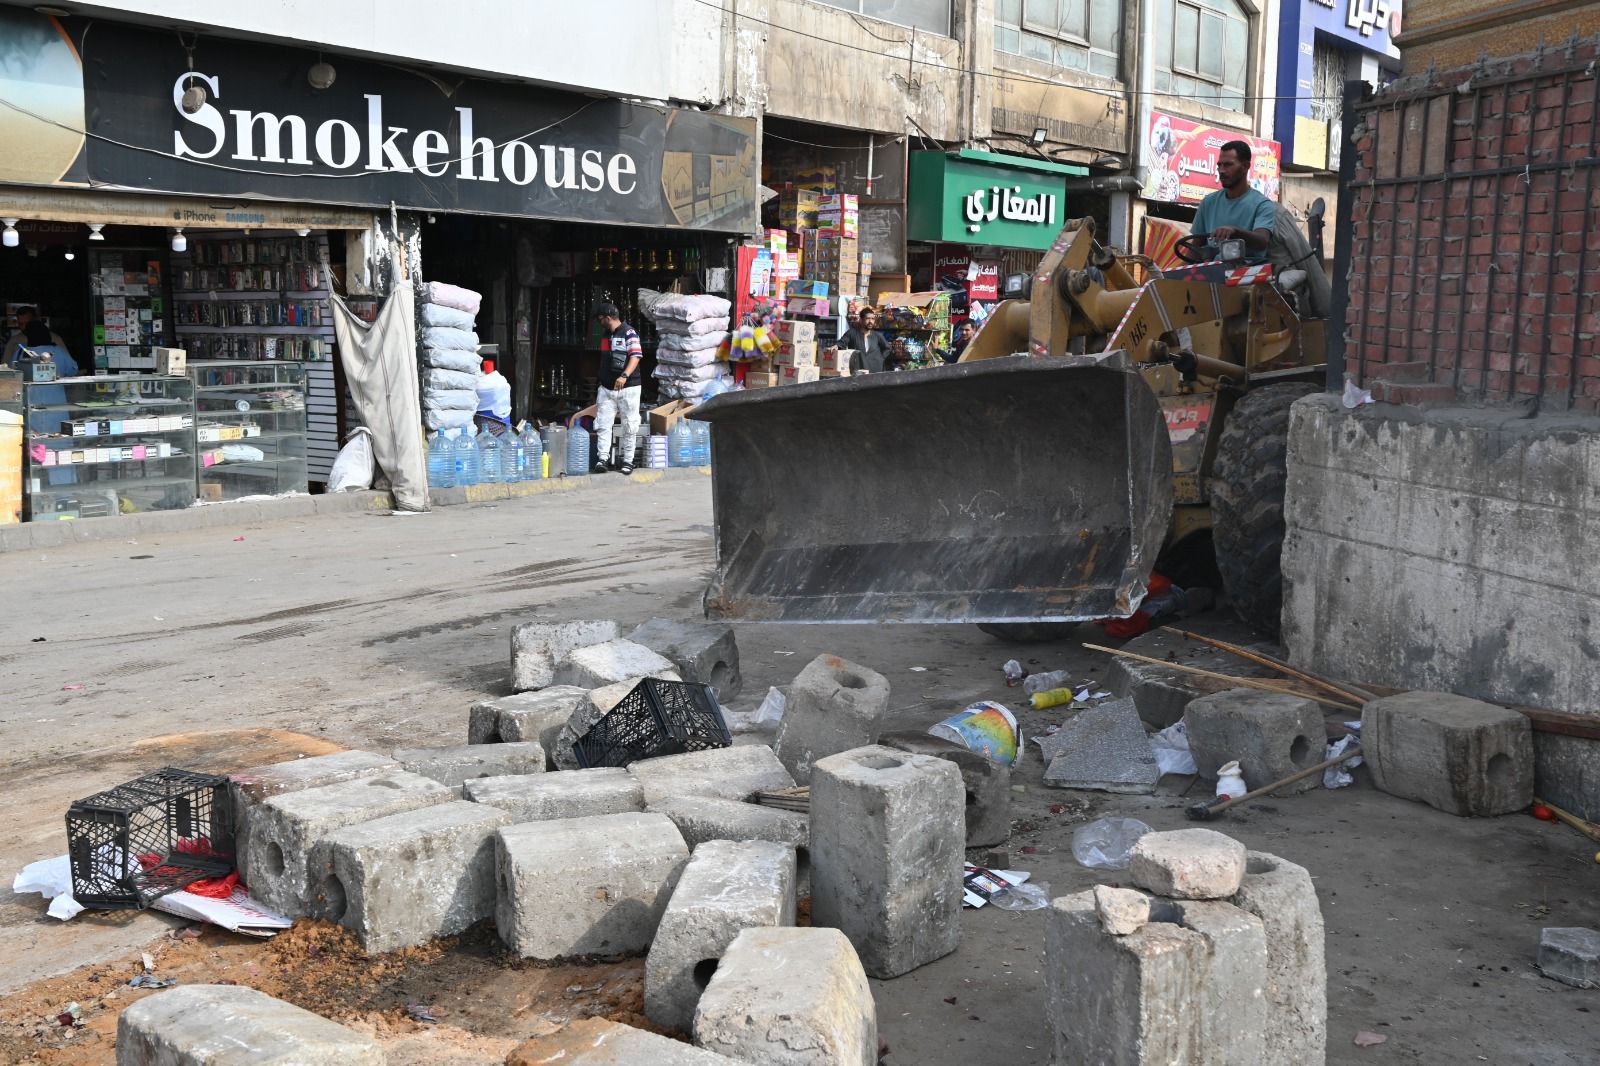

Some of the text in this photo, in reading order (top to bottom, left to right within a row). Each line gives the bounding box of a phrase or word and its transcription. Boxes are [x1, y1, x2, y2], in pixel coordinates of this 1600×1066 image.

[172, 71, 637, 195] Smokehouse
[966, 185, 1056, 233] المغازي
[183, 210, 216, 223] iPhone
[226, 212, 265, 223] SAMSUNG
[977, 264, 998, 277] المغاز
